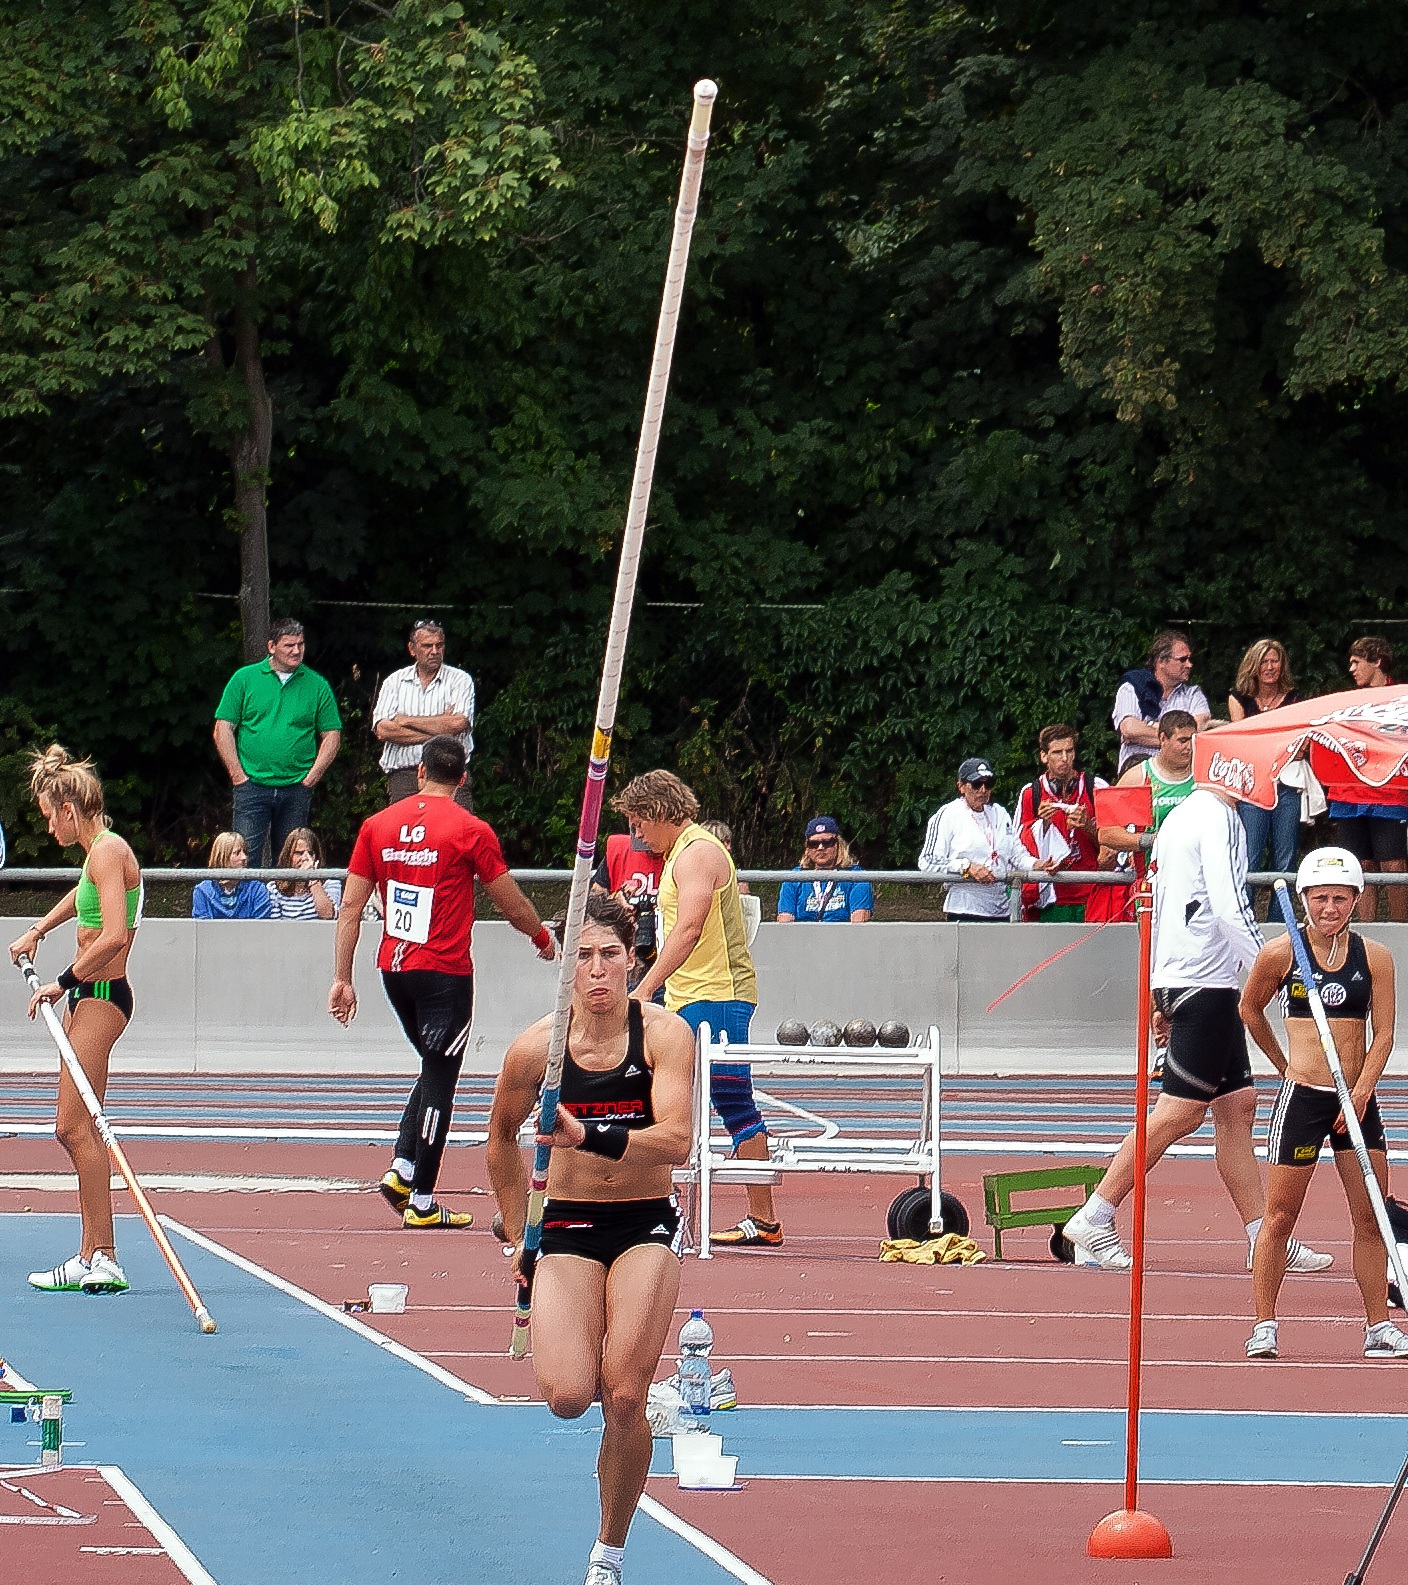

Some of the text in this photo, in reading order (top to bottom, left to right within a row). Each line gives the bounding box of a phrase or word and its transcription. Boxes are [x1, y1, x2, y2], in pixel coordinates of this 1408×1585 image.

[399, 824, 426, 843] LG
[394, 908, 413, 933] 20
[562, 1100, 643, 1116] ETZNER
